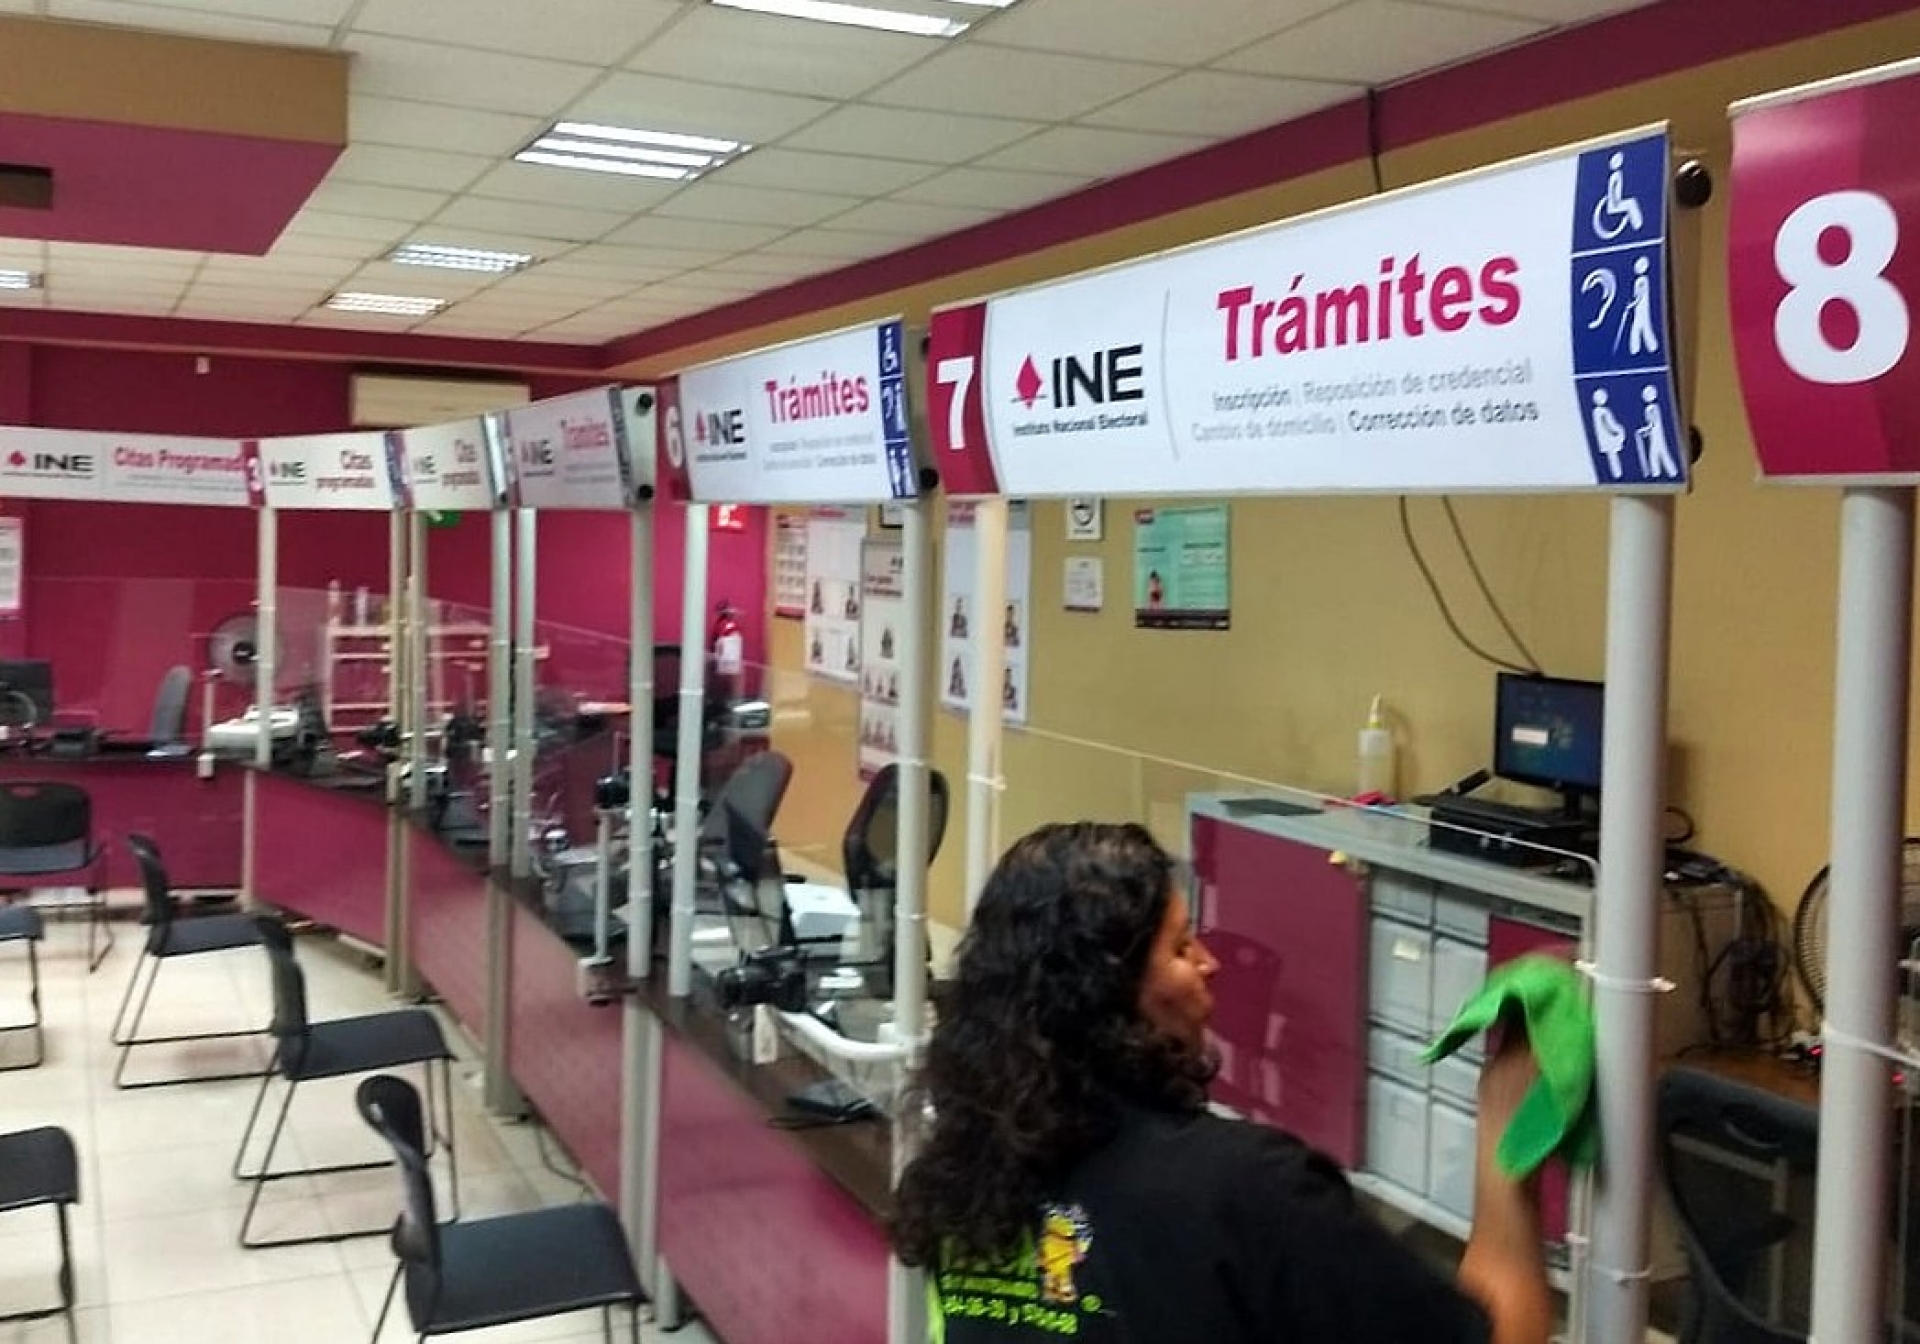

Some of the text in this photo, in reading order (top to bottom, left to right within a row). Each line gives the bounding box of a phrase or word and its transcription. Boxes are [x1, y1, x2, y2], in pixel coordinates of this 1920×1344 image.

[1217, 253, 1521, 361] Trámites
[1774, 190, 1910, 384] 8
[765, 370, 869, 424] Trámites
[1052, 344, 1144, 409] INE
[1213, 357, 1532, 412] Inscripción Reposición de credencial
[936, 355, 975, 450] 7
[1053, 419, 1096, 433] Nacional
[1098, 411, 1148, 430] Electoral
[1246, 420, 1262, 439] de
[1266, 416, 1337, 437] domicilio
[1348, 403, 1447, 432] Corrección
[1451, 402, 1476, 426] de
[1480, 398, 1540, 425] datos
[665, 406, 683, 468] 6
[708, 408, 744, 446] INE
[34, 453, 94, 472] INE
[114, 447, 153, 468] Citas
[280, 461, 305, 478] INE
[341, 450, 373, 470] Citas
[520, 439, 552, 465] INE
